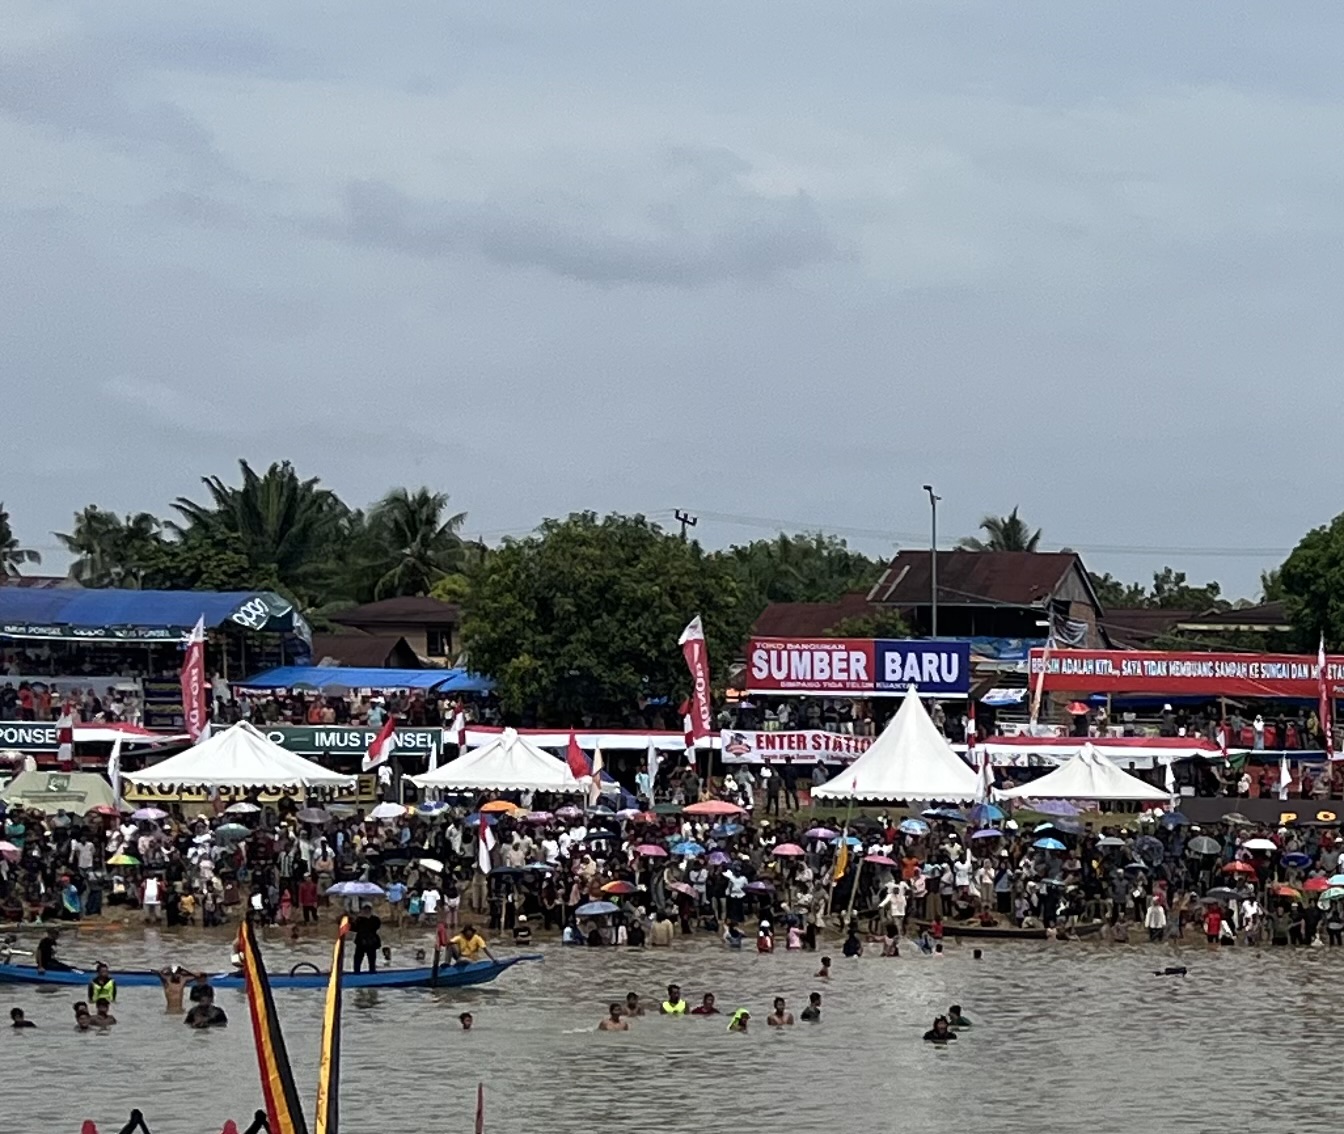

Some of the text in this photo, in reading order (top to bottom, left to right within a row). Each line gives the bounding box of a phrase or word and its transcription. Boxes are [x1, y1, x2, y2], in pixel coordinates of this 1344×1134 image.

[752, 650, 960, 683] SUMBER BARU
[1061, 657, 1094, 675] ADALAH
[1122, 659, 1142, 676] SAYA
[1143, 660, 1167, 676] TIDAK
[1215, 661, 1247, 678] SAMPAH
[1249, 662, 1260, 678] KE
[1260, 662, 1289, 679] SUNGAI
[1291, 663, 1309, 679] DAN
[315, 732, 435, 748] IMUS PNSEL
[755, 734, 807, 750] ENTER
